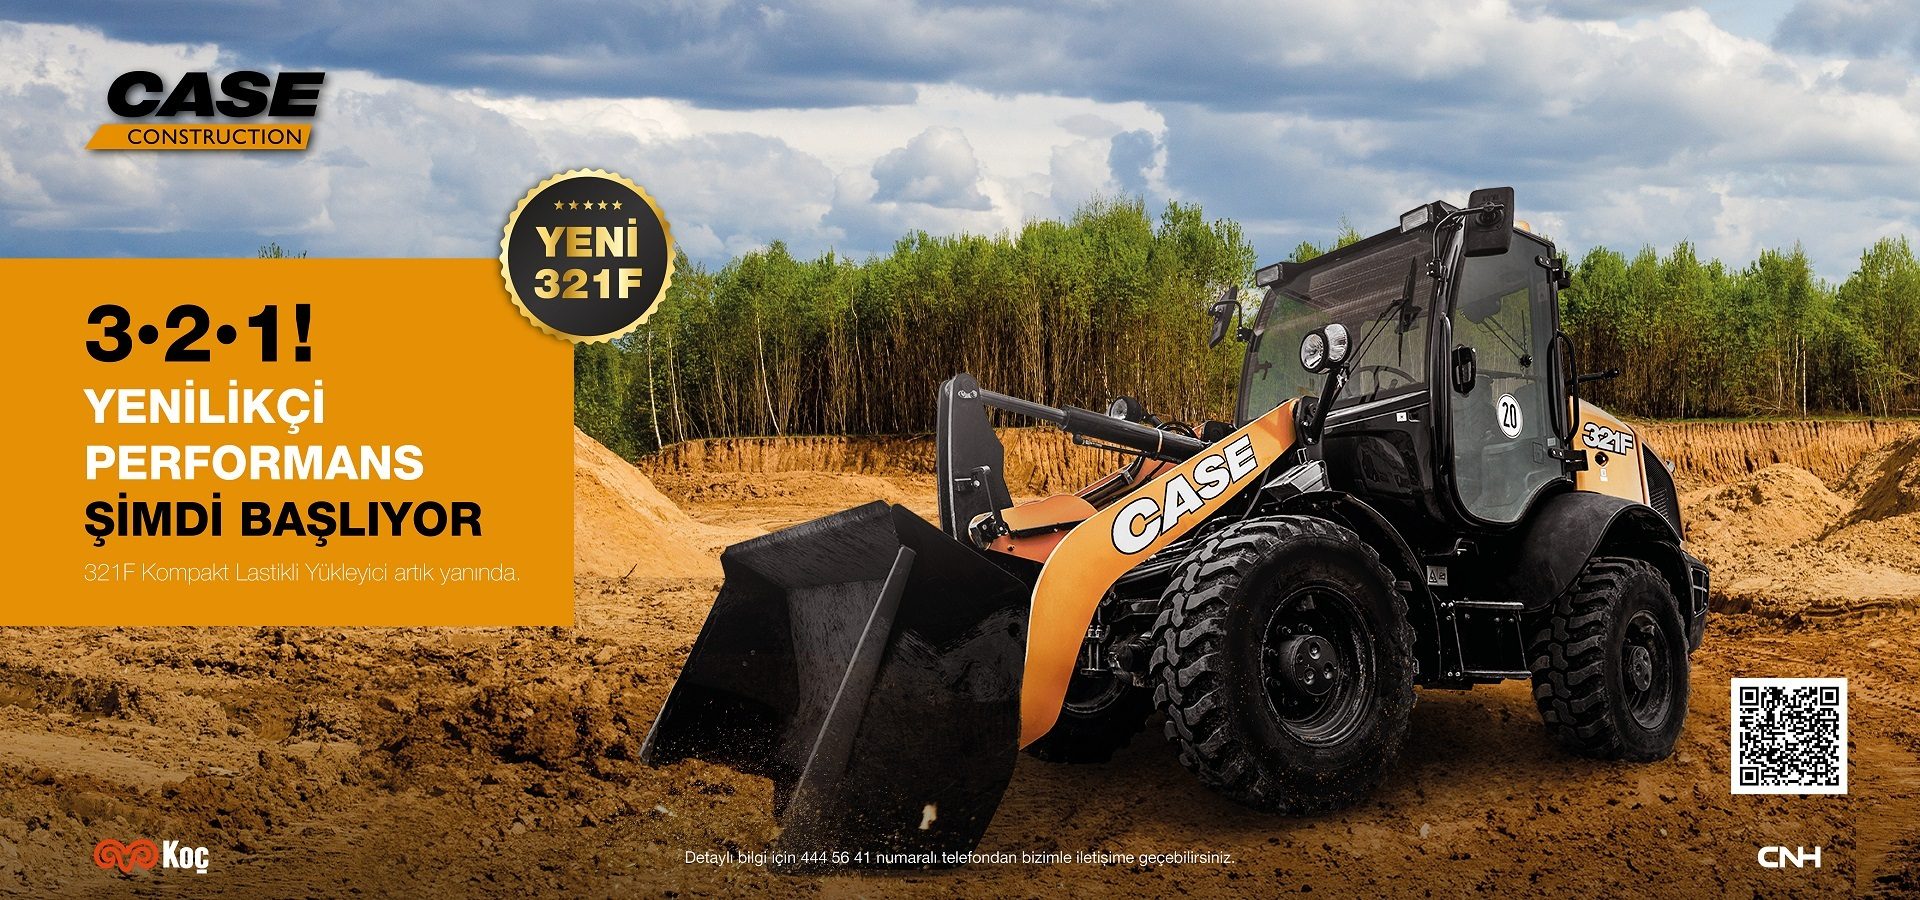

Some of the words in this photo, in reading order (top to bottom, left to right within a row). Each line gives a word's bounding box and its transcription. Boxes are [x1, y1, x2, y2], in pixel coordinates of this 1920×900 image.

[1502, 402, 1518, 429] 20
[1582, 422, 1634, 456] 321F
[1110, 433, 1259, 555] CASE
